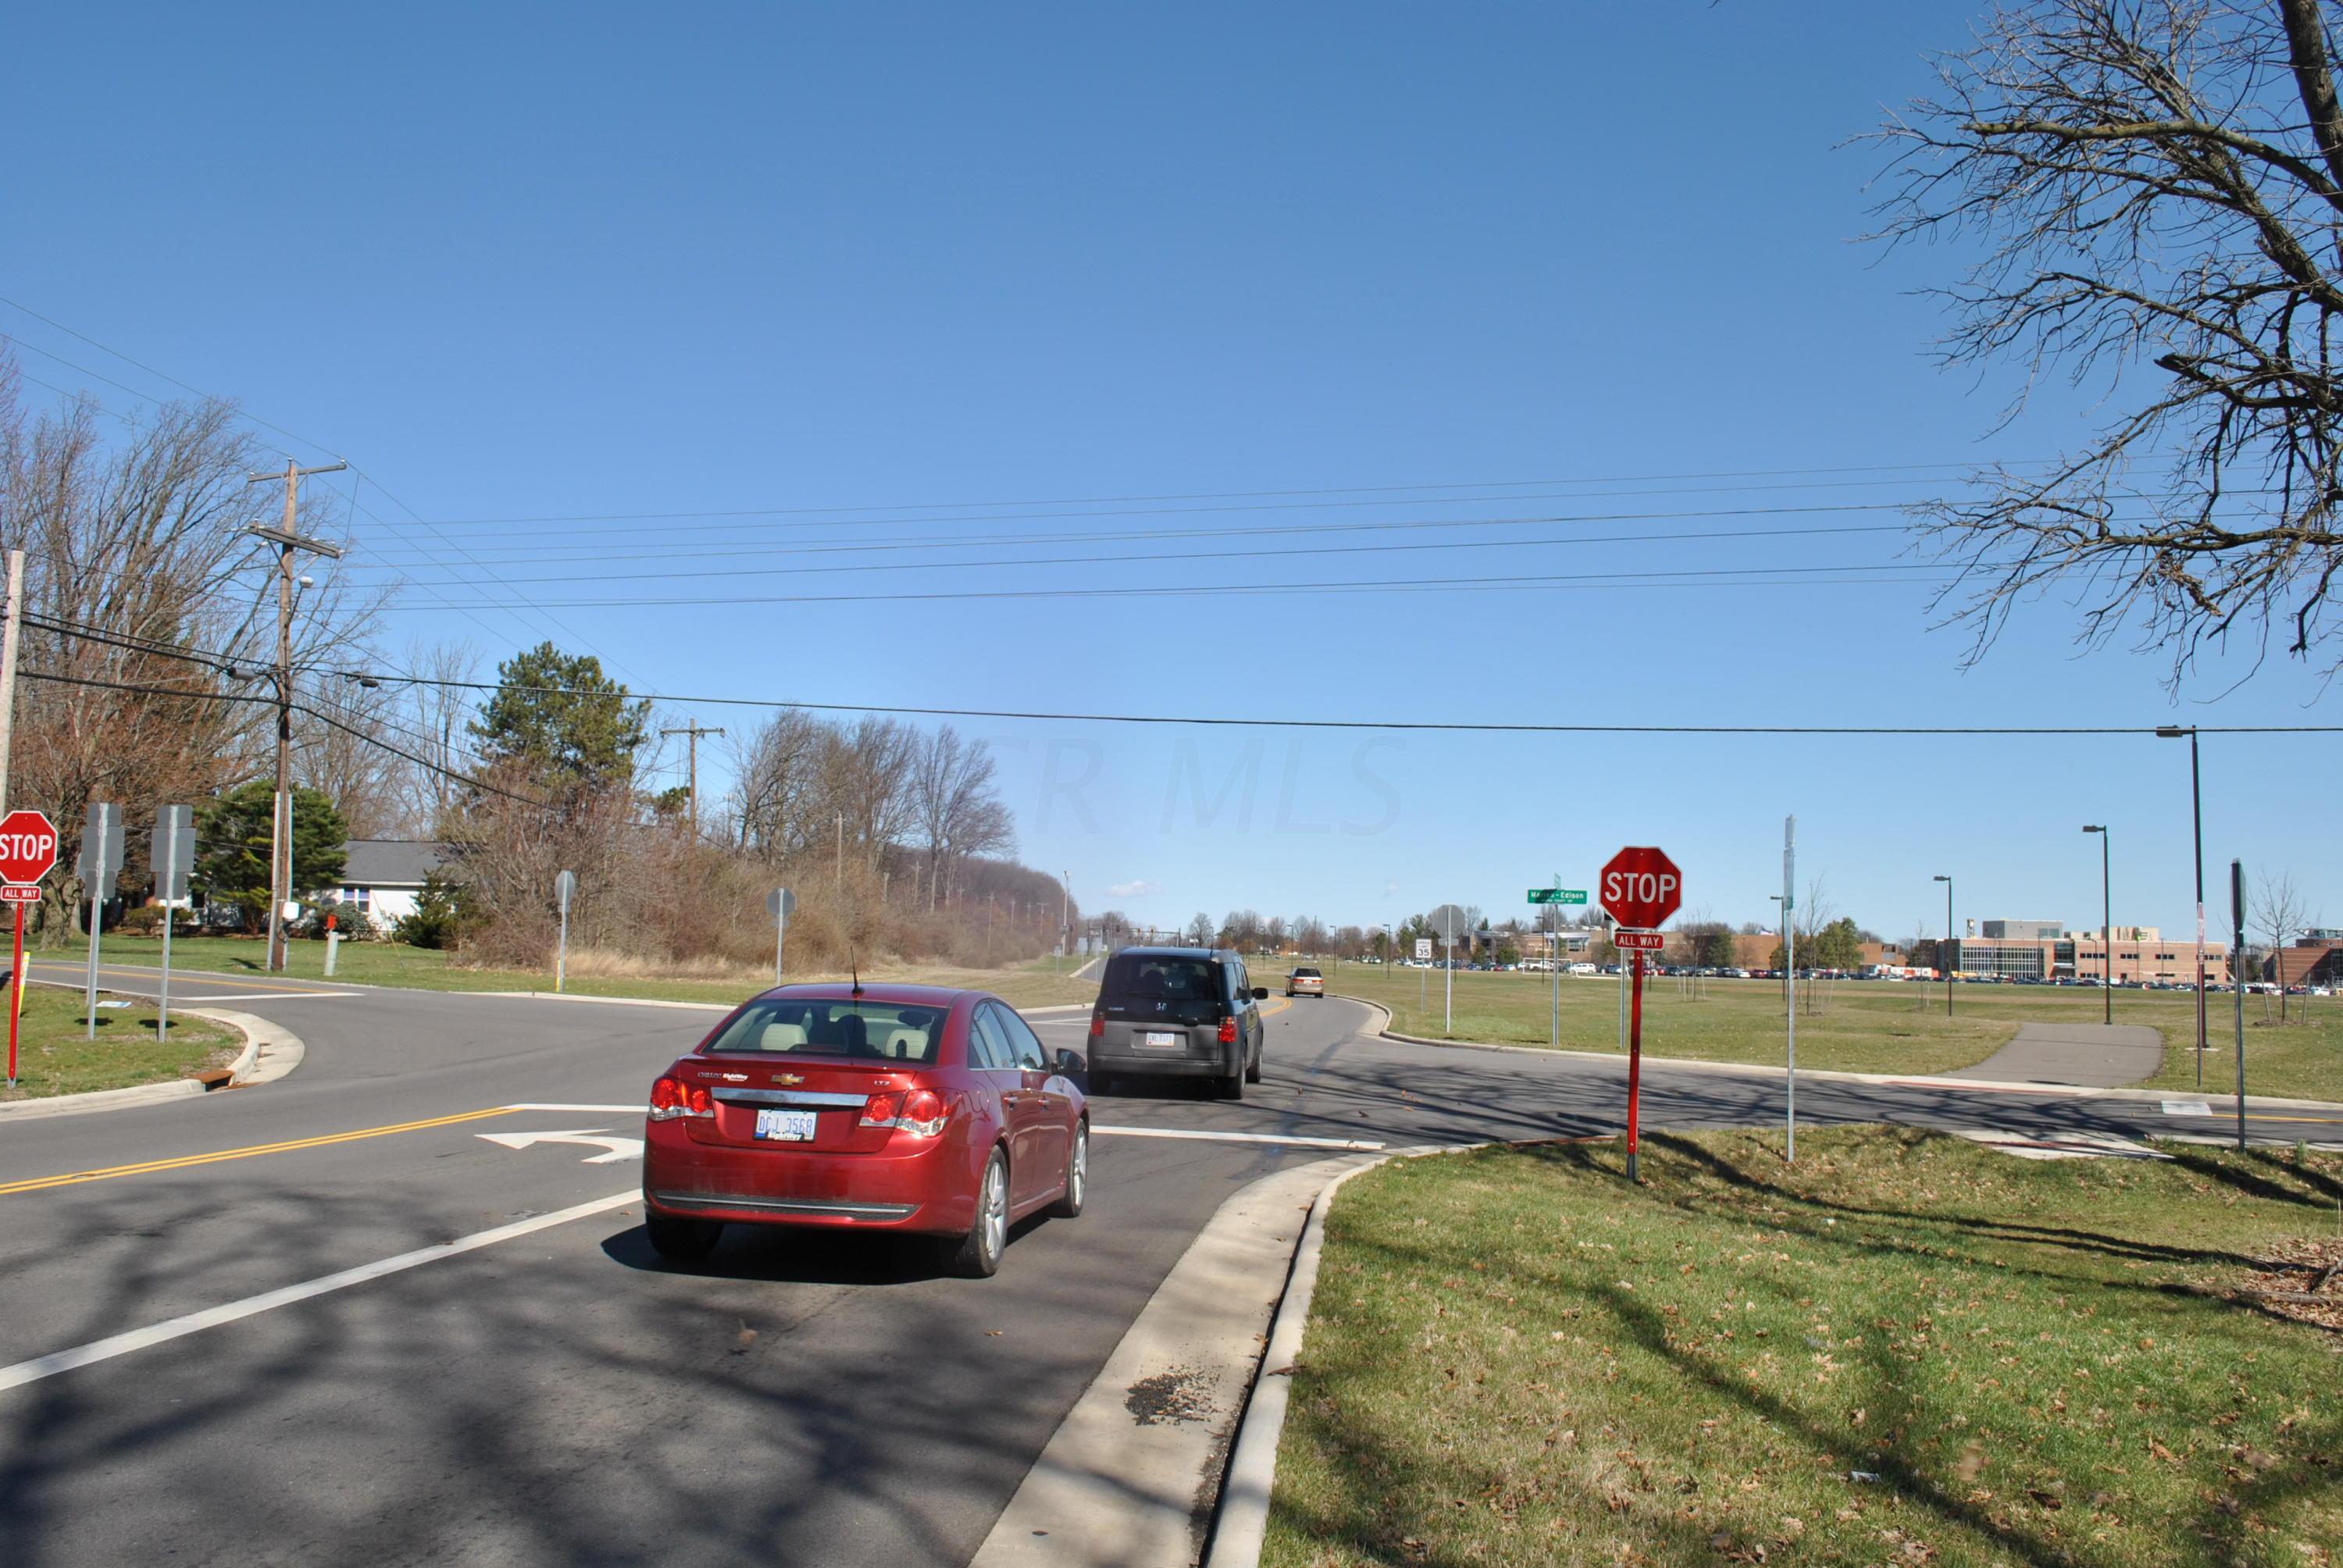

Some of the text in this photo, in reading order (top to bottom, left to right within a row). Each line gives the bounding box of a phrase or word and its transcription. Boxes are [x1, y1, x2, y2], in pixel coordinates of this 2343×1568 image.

[0, 833, 52, 861] STOP
[5, 889, 37, 899] ALL WAY
[1604, 871, 1677, 903] STOP
[1619, 935, 1660, 946] ALL WAY
[758, 1116, 779, 1132] DCJ
